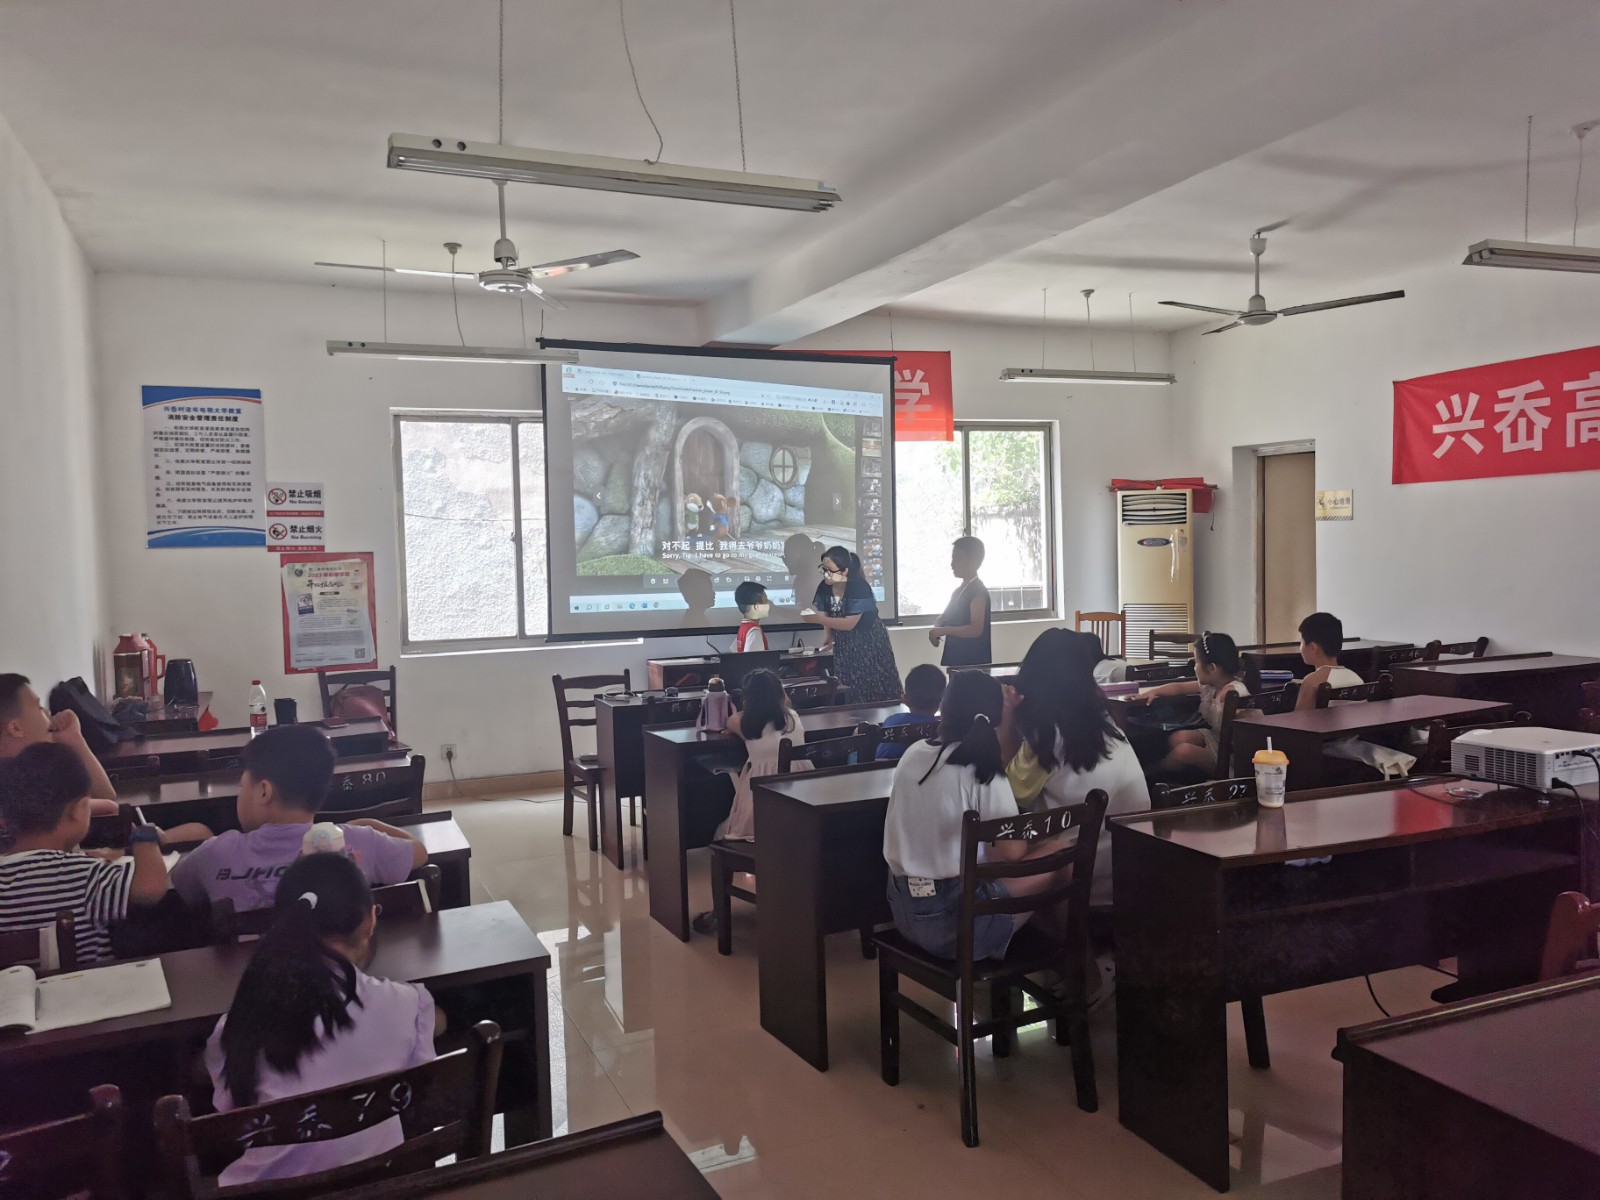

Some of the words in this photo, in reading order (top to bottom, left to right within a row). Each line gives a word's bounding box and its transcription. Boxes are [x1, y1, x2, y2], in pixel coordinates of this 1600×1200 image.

[894, 369, 933, 425] 学
[1432, 371, 1600, 460] 兴岙高
[289, 489, 322, 499] 禁止吸烟
[290, 525, 323, 534] 禁止烟火
[662, 540, 691, 551] 对不起
[696, 540, 715, 551] 提比
[662, 552, 681, 560] Sorry,
[722, 552, 730, 560] go
